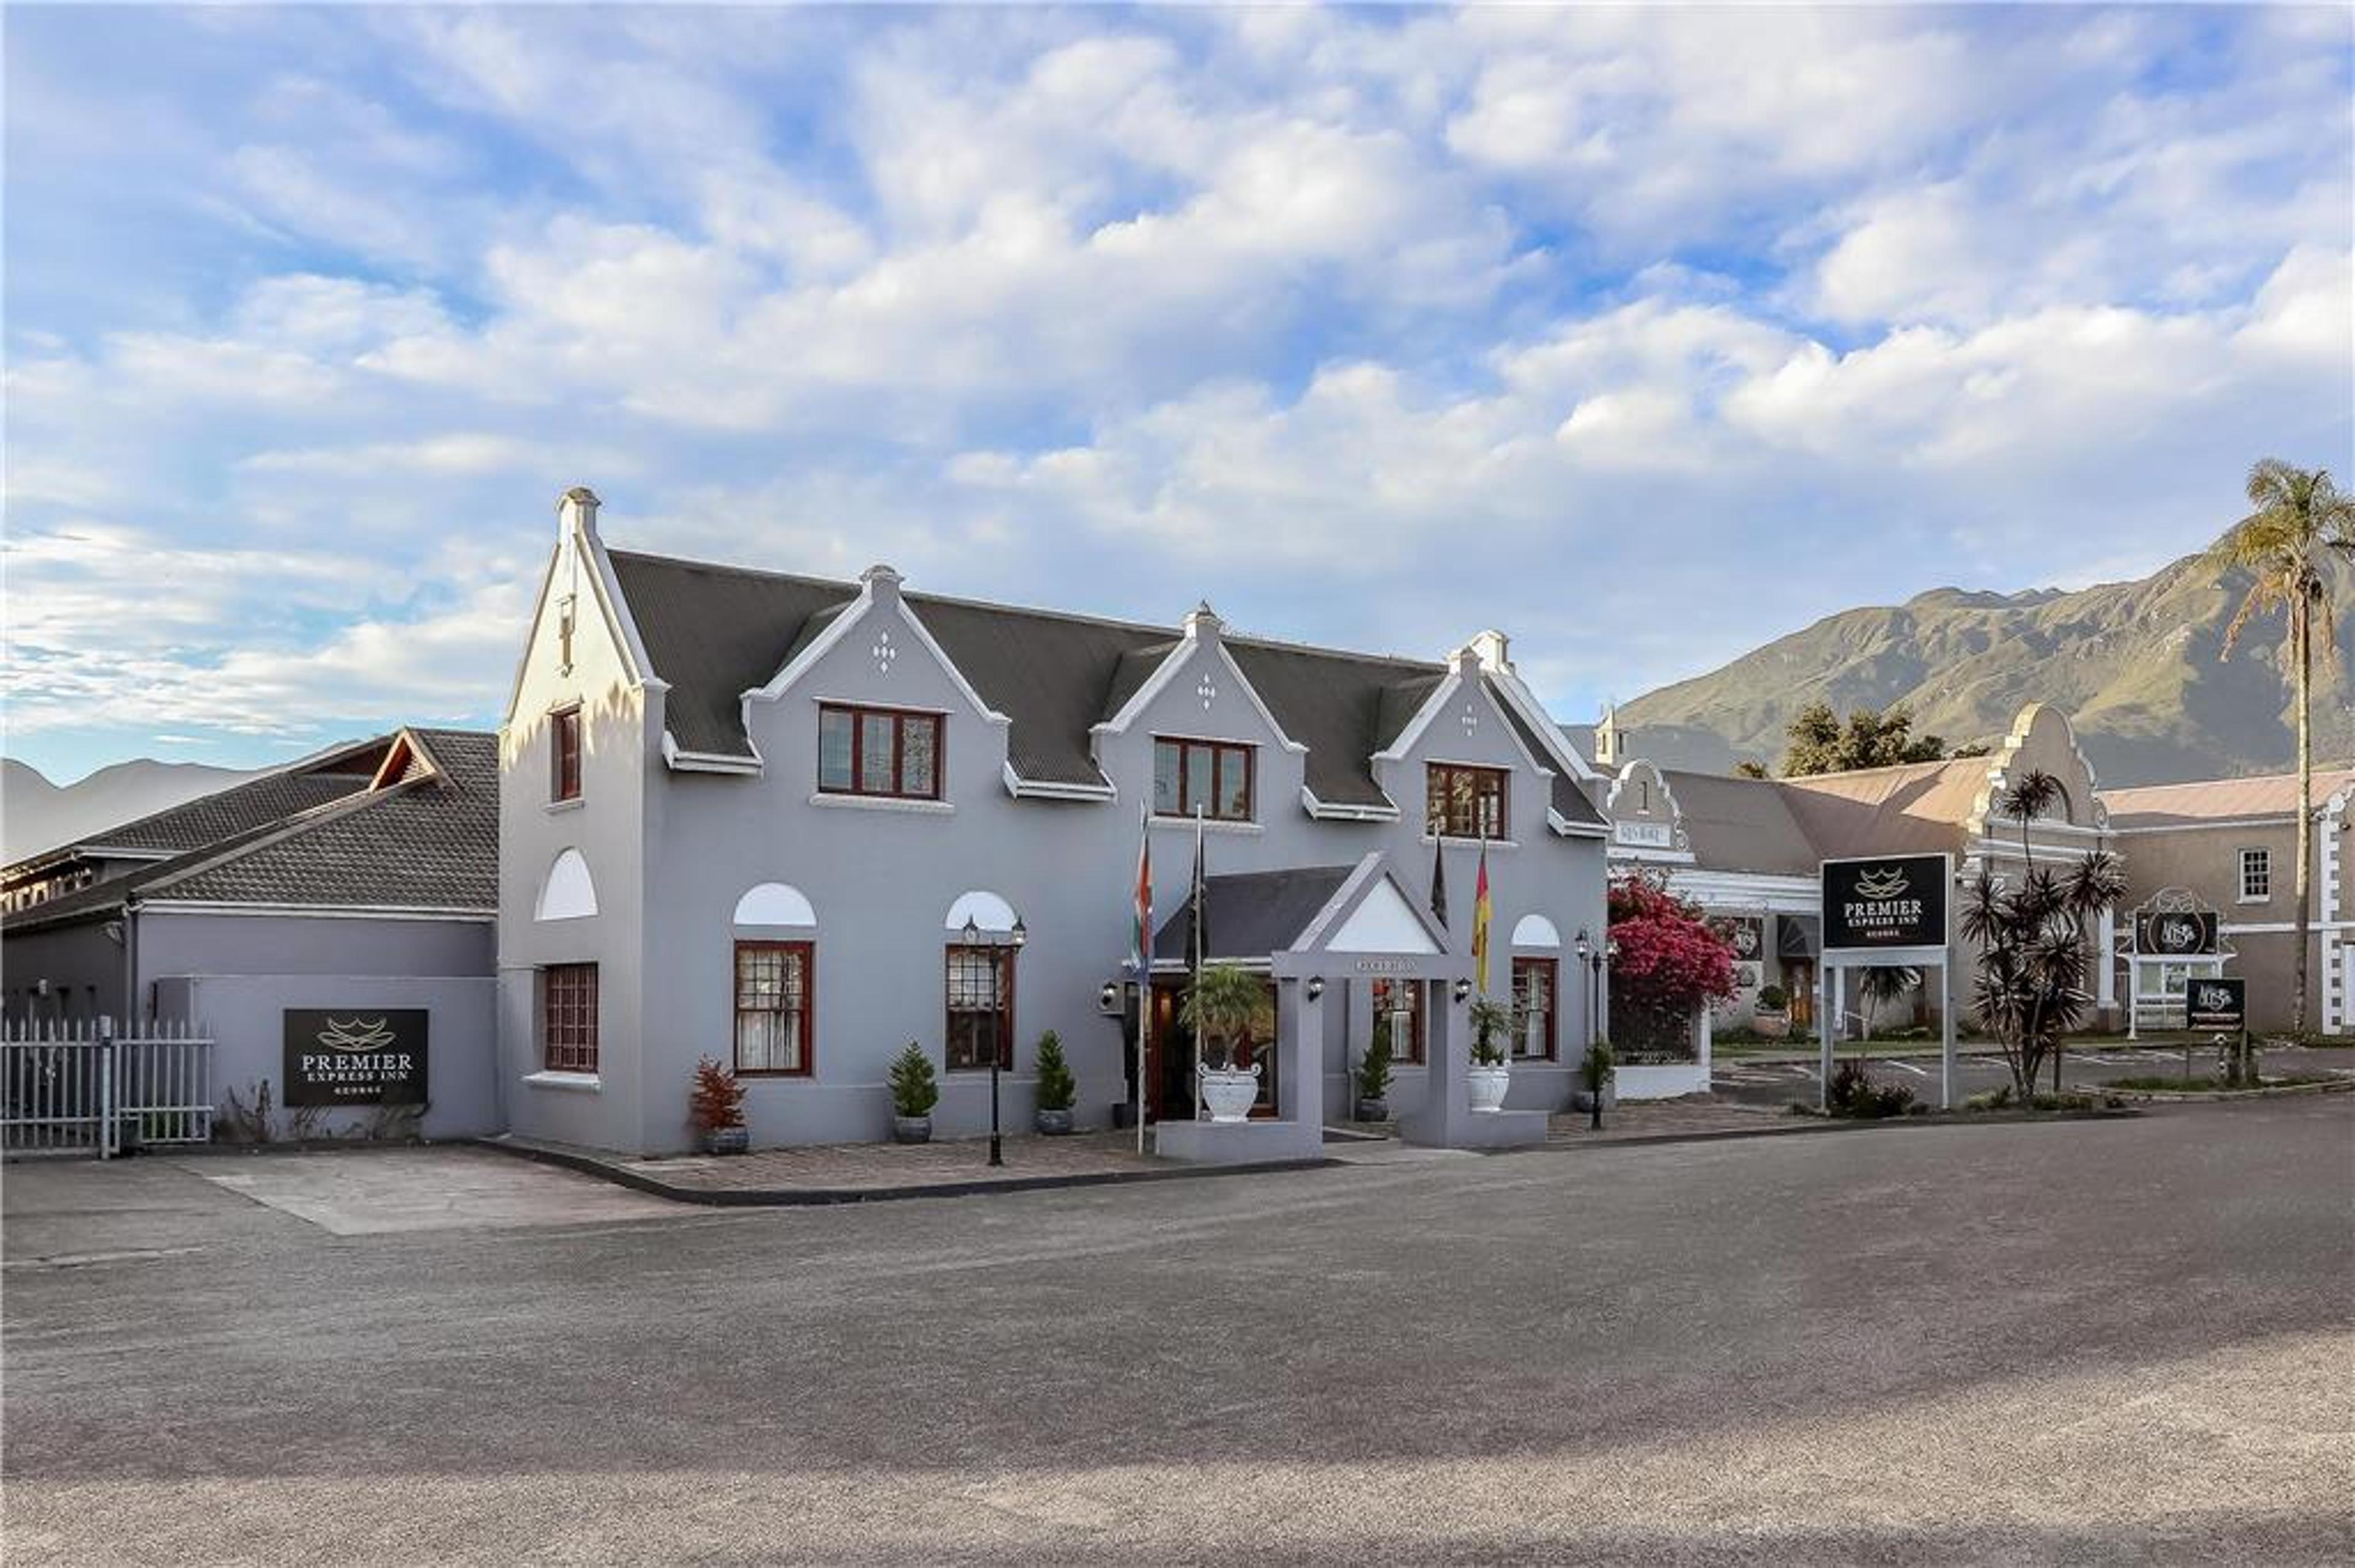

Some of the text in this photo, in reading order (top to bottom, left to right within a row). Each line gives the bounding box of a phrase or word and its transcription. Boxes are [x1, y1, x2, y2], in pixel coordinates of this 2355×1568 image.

[1844, 900, 1922, 917] PREMIER
[302, 1054, 413, 1071] PREMIER
[307, 1071, 408, 1081] EXPRESS INN
